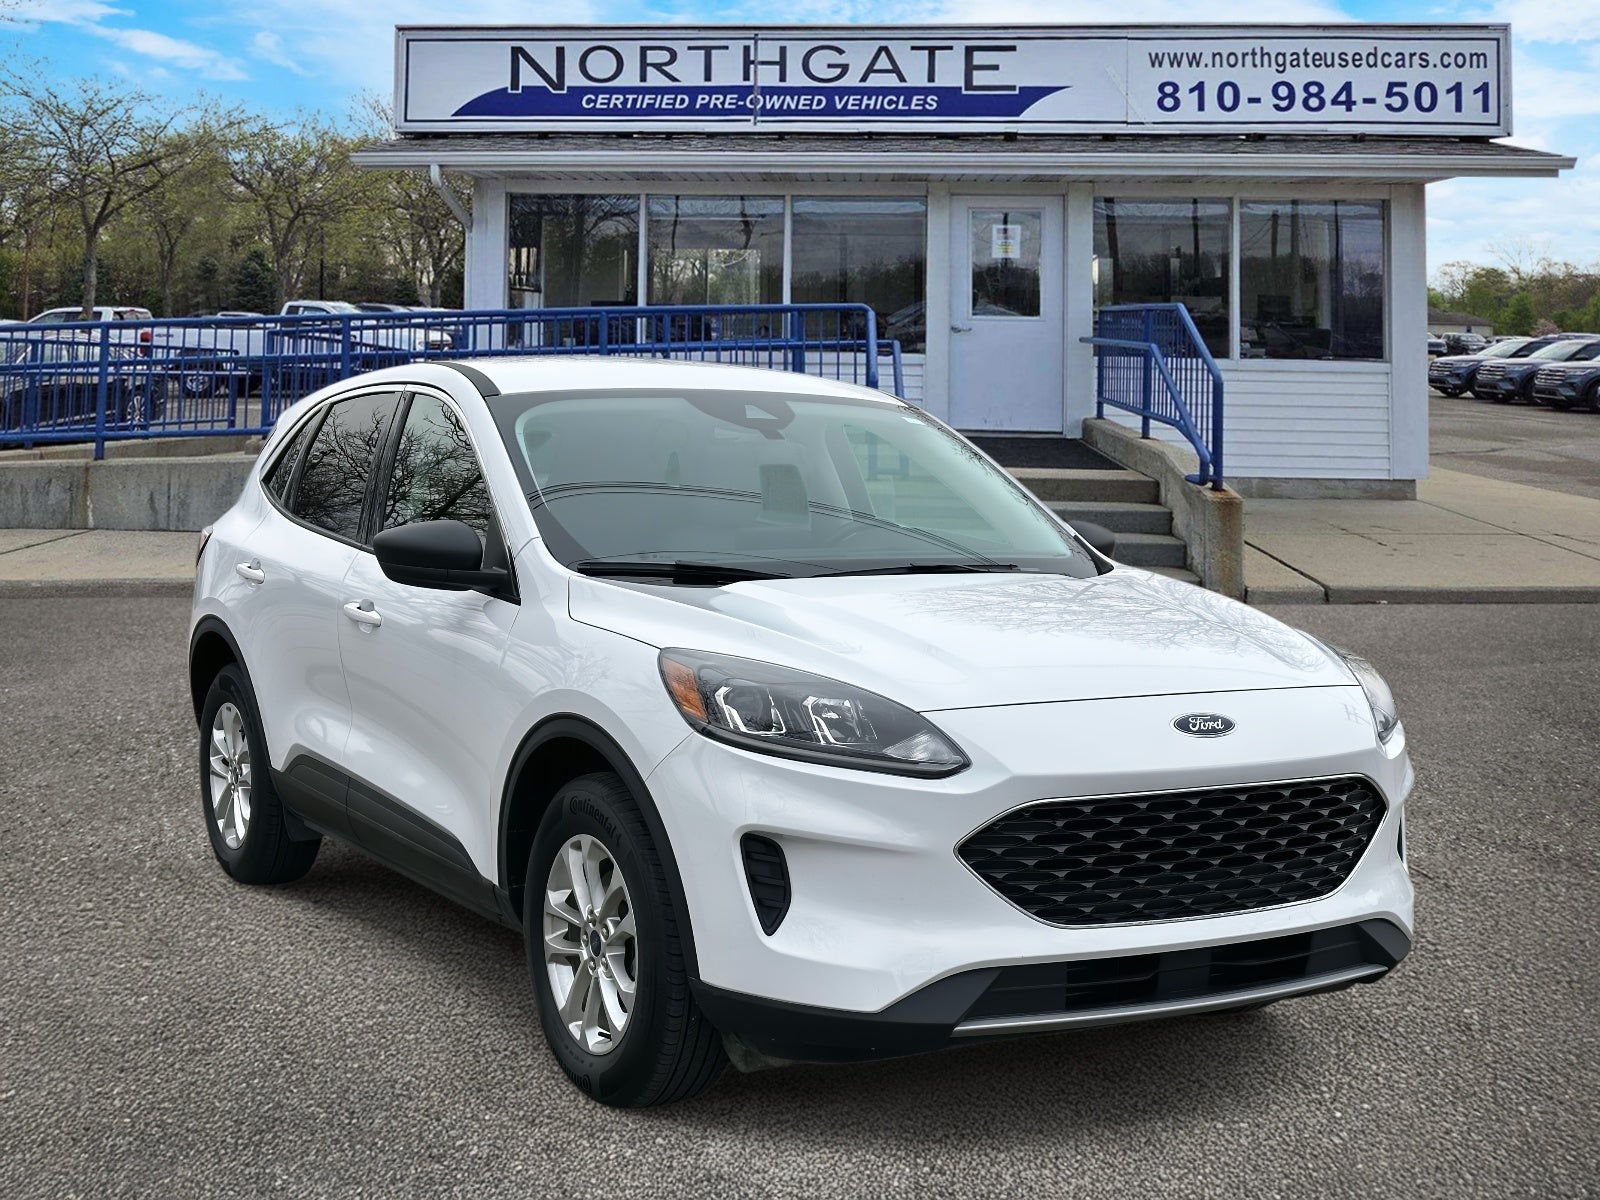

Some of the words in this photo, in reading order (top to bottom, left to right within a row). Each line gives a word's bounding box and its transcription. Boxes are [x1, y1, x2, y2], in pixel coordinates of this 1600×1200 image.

[509, 44, 1018, 92] NORTHGATE
[1148, 46, 1488, 74] www.northgateusedcars.com
[581, 94, 690, 110] CERTIFIED
[695, 94, 827, 111] PRE-OWNED
[833, 94, 939, 111] VEHICLES
[1156, 81, 1491, 113] 810-984-5011
[1188, 715, 1225, 731] Ford
